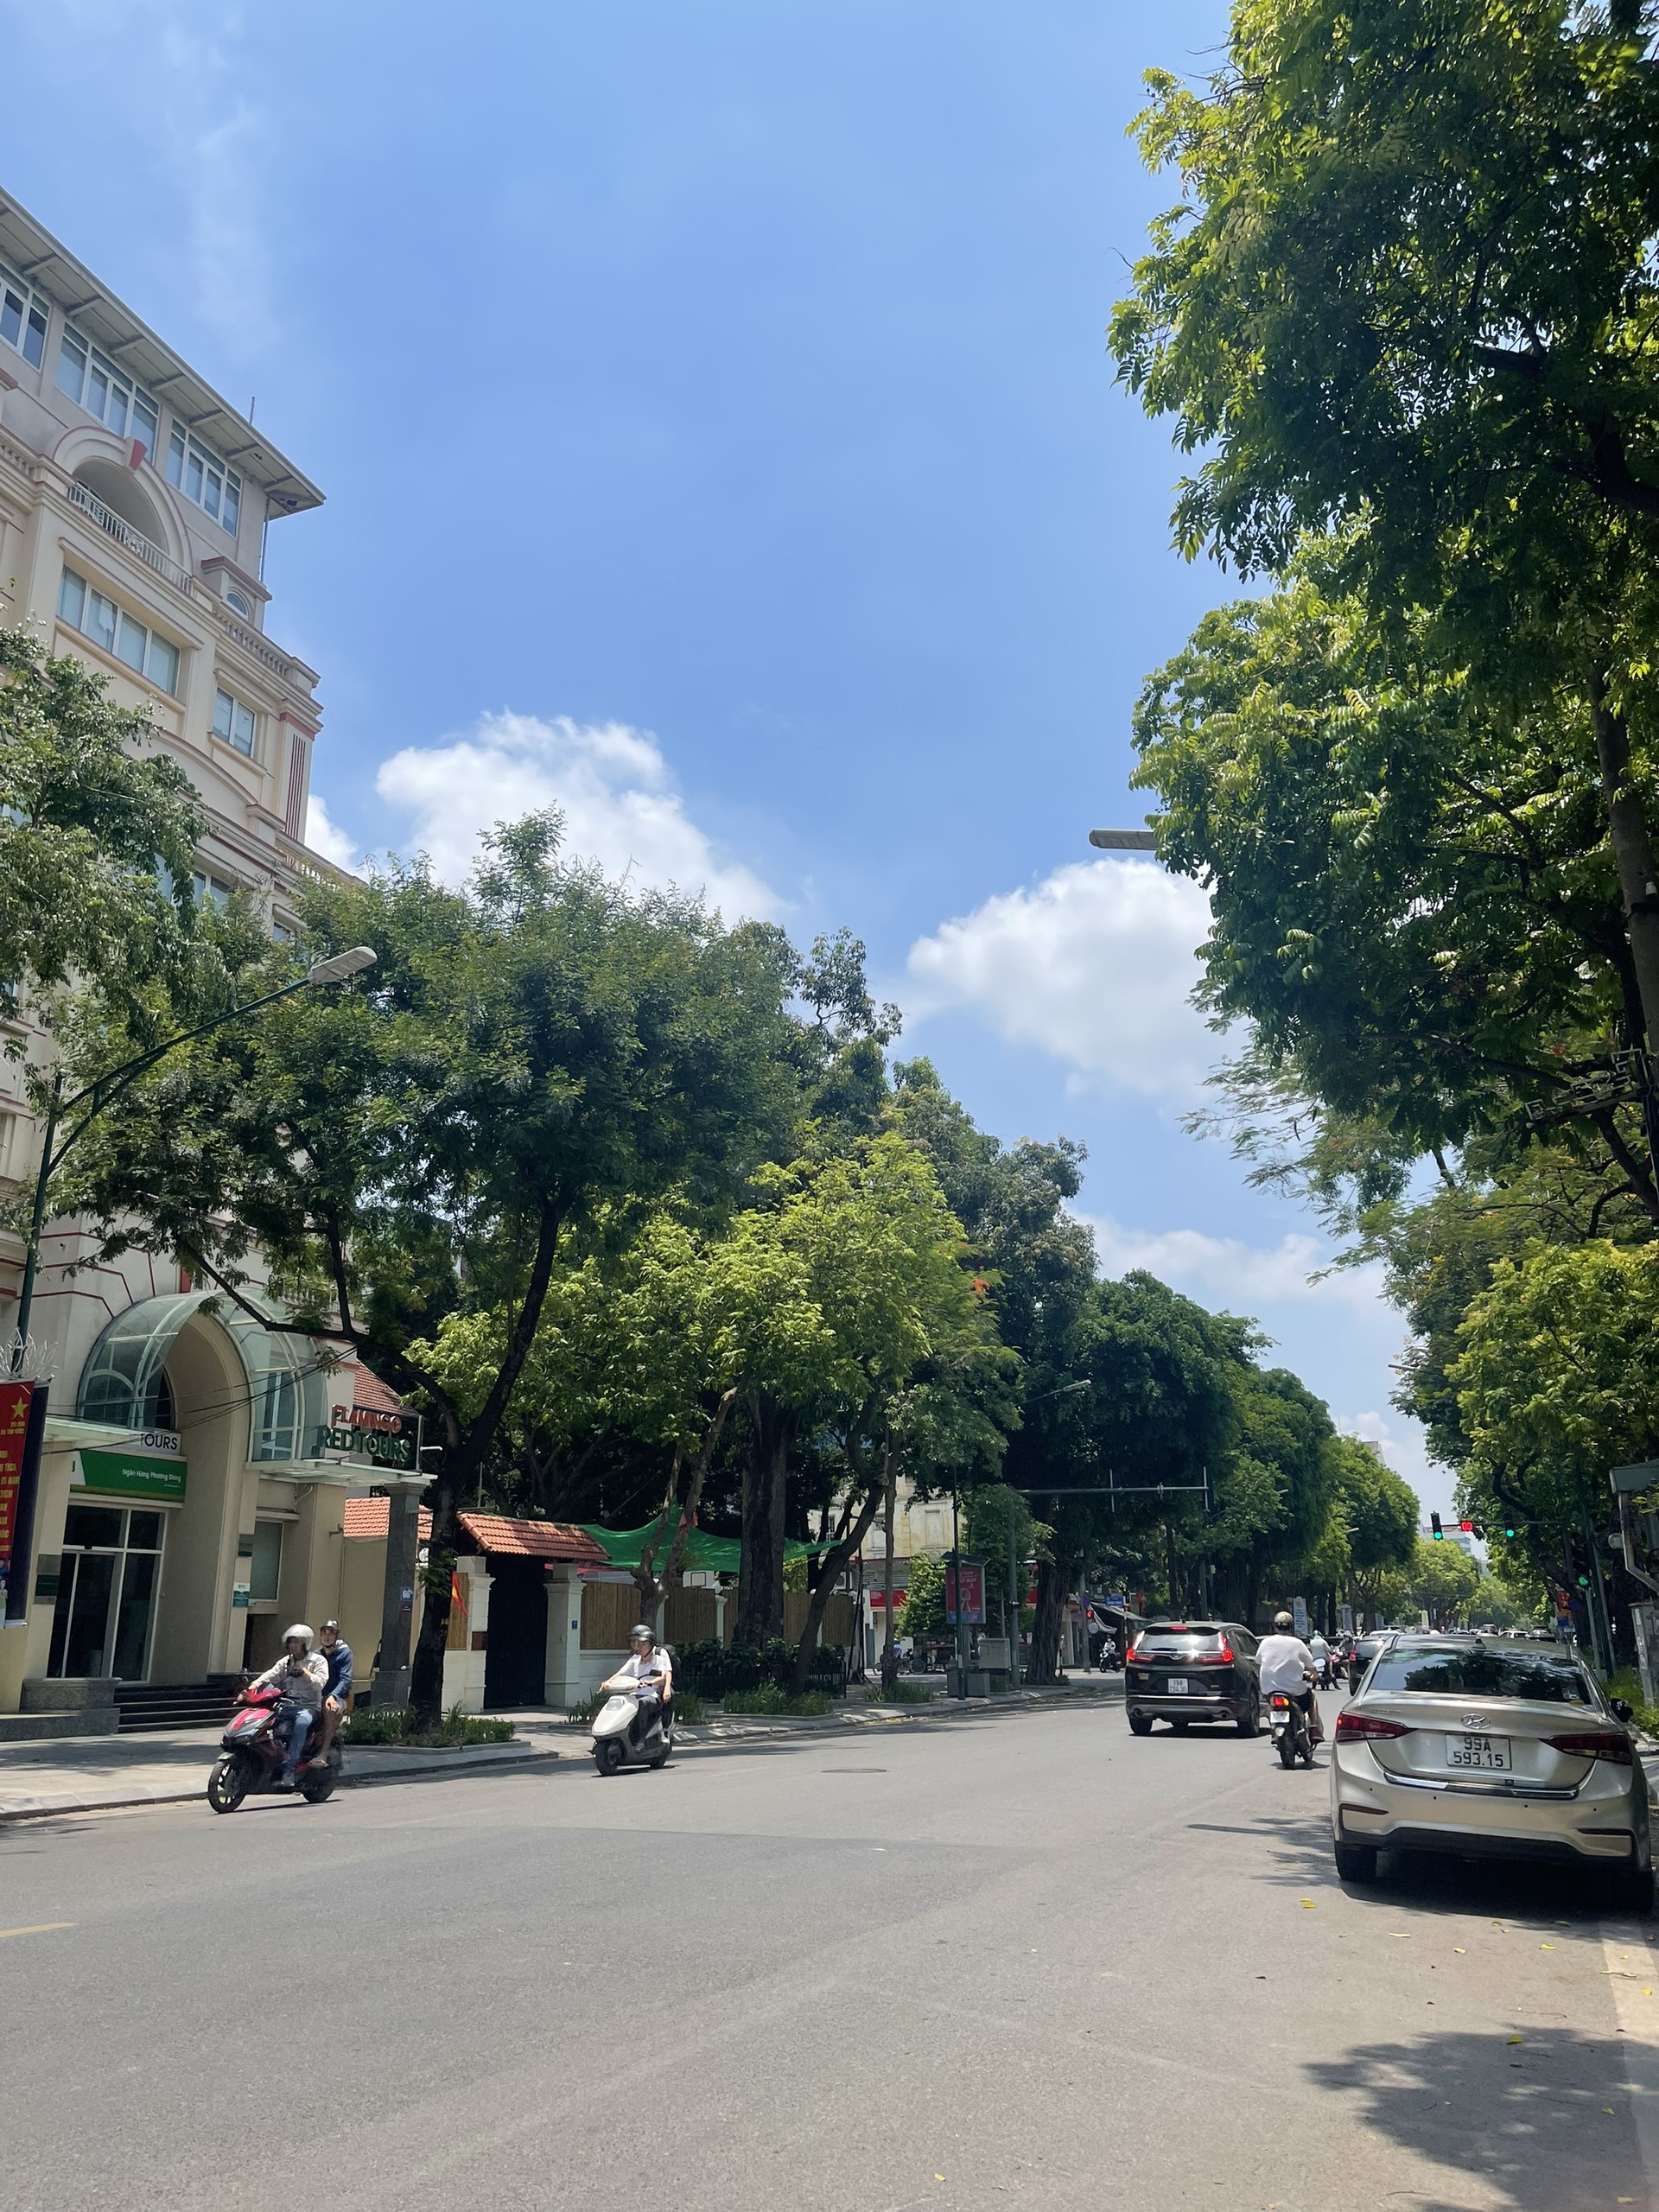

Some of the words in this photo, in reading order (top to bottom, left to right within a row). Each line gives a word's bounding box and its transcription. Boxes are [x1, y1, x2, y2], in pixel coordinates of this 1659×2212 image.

[331, 1403, 402, 1433] FLAMINGO
[1464, 1737, 1491, 1751] 99A
[1453, 1751, 1503, 1767] 593.15
